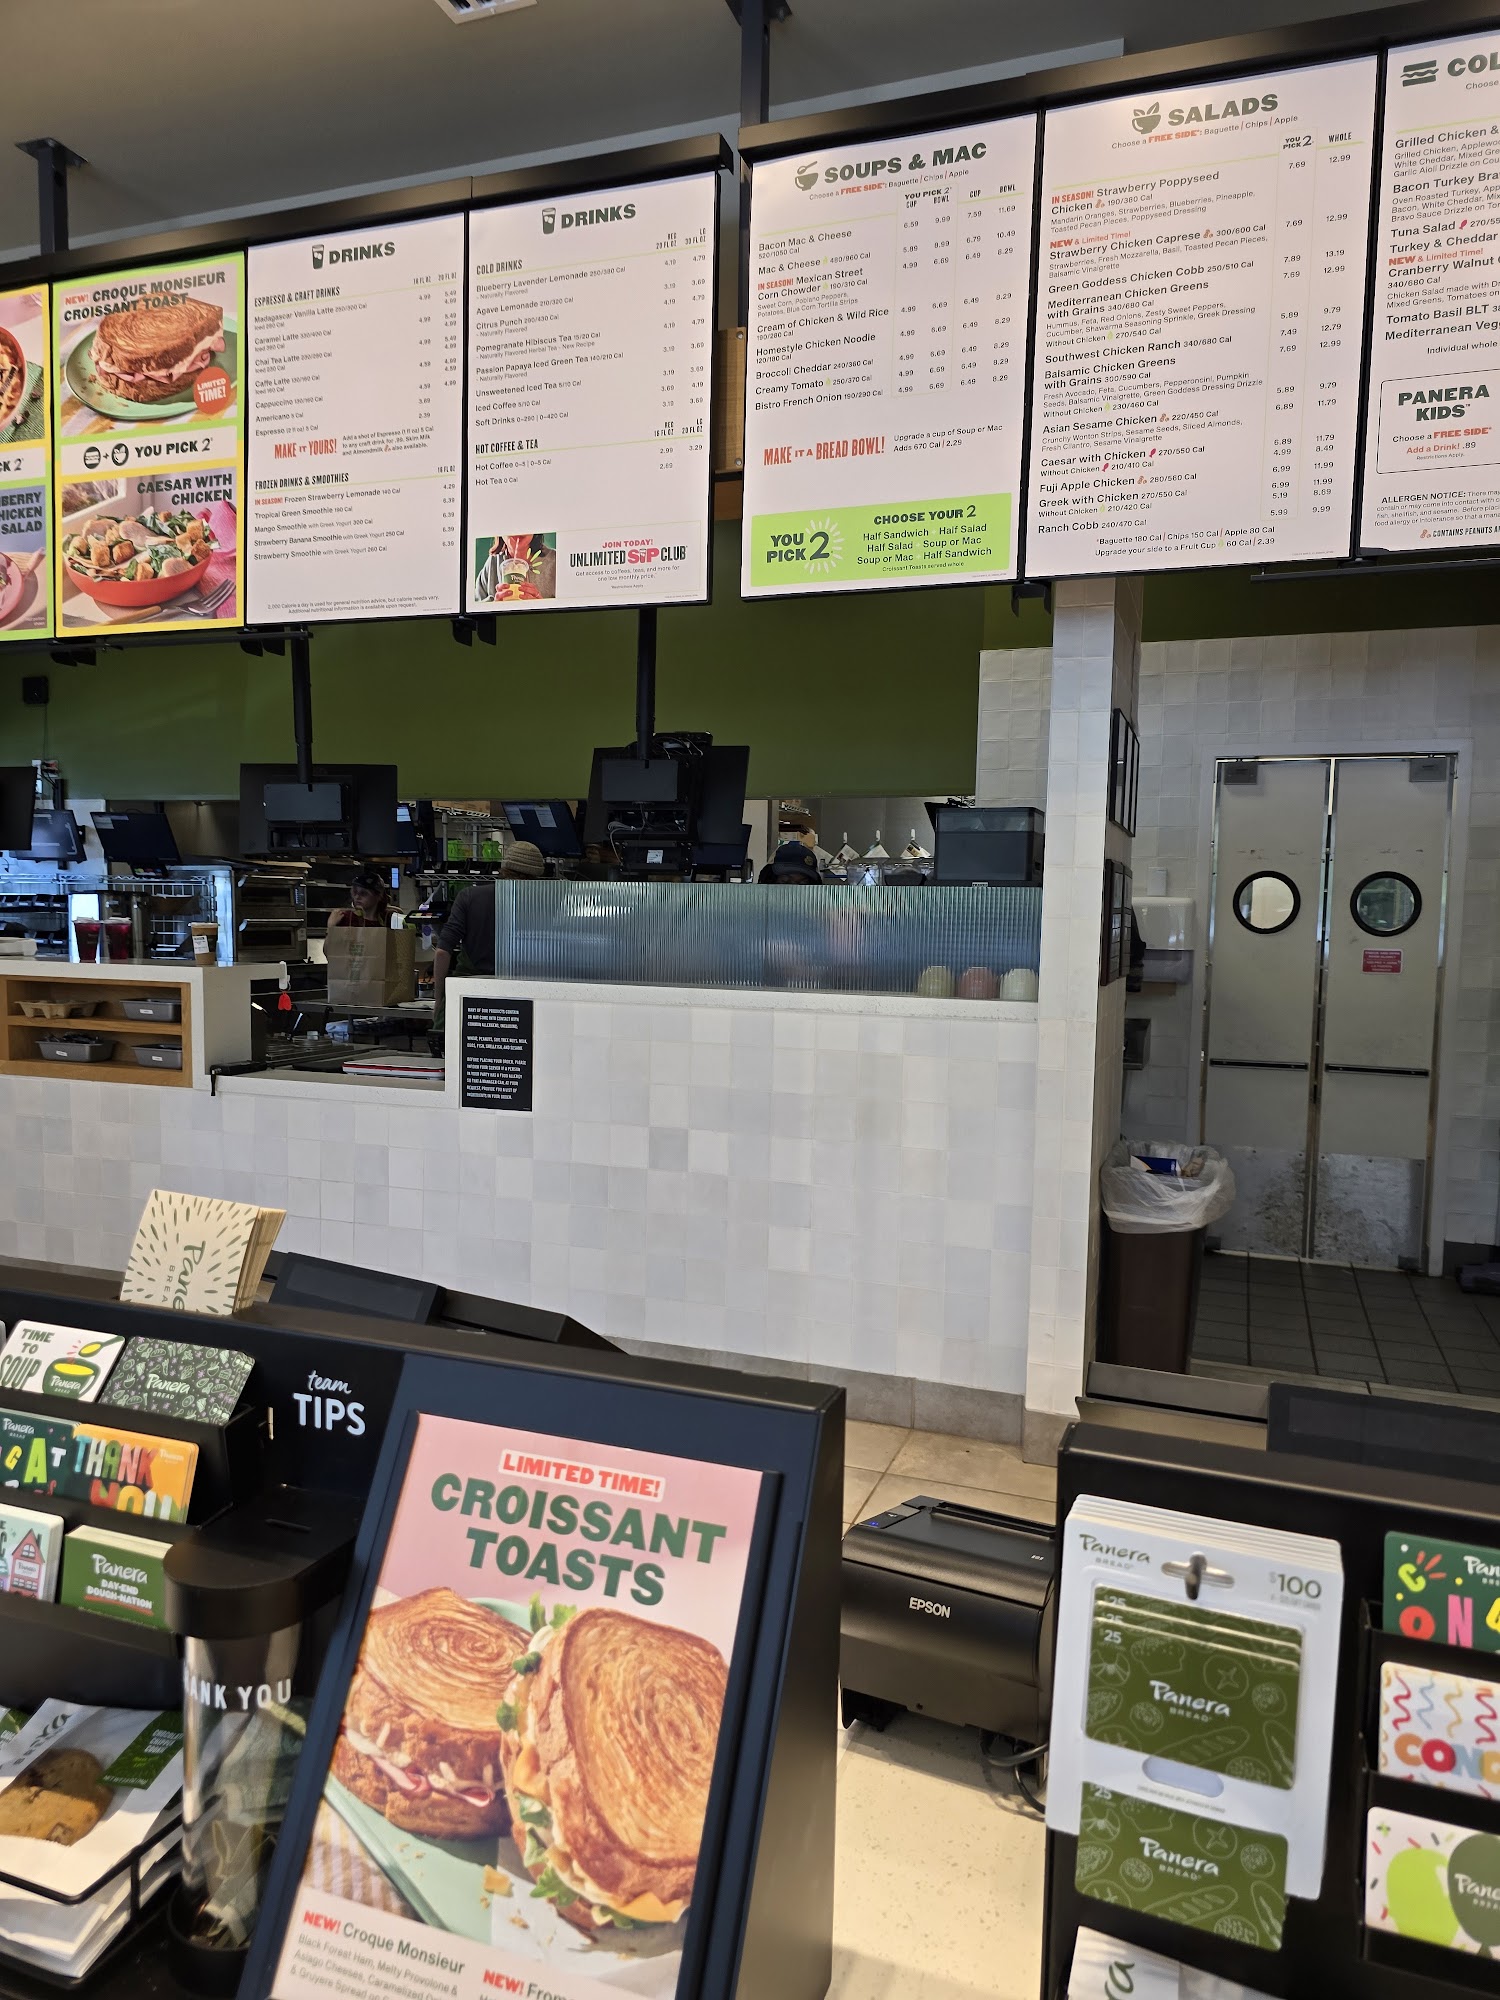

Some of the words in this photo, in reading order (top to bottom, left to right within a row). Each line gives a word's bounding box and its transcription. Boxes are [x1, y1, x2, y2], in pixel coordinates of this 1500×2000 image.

[1168, 93, 1279, 127] SALADS
[1328, 131, 1352, 143] WHOLE
[824, 156, 902, 184] SOUPS
[908, 153, 927, 171] &
[932, 142, 987, 167] MAC
[1289, 160, 1306, 169] 7.69
[1329, 154, 1351, 163] 12.99
[1393, 182, 1430, 194] Bacon
[1433, 175, 1475, 188] Turkey
[561, 203, 636, 230] DRINKS
[1390, 227, 1420, 238] Tuna
[1422, 220, 1456, 234] Salad
[328, 241, 396, 265] DRINKS
[1049, 245, 1108, 260] Strawberry
[1110, 238, 1153, 251] Chicken
[1155, 232, 1201, 245] Caprese
[1389, 241, 1431, 254] Turkey
[1433, 238, 1443, 248] &
[1446, 232, 1499, 246] Cheddar
[476, 263, 494, 275] COLD
[496, 259, 523, 273] DRINKS
[65, 294, 89, 305] NEW!
[92, 283, 147, 302] CROQUE
[150, 271, 226, 295] MONSIEUR
[1048, 283, 1079, 294] Green
[1081, 276, 1128, 289] Goddess
[1130, 270, 1173, 282] Chicken
[1175, 265, 1205, 277] Cobb
[64, 300, 139, 322] CROISSANT
[145, 292, 189, 310] TOAST
[254, 294, 286, 308] ESPRESSO
[287, 293, 293, 303] &
[294, 289, 314, 302] CRAFT
[316, 286, 340, 299] DRINKS
[757, 323, 785, 333] Cream
[787, 319, 797, 329] of
[798, 316, 835, 327] Chicken
[836, 313, 844, 322] &
[846, 310, 866, 321] Wild
[868, 308, 889, 318] Rice
[1386, 312, 1430, 325] Tomato
[1433, 306, 1462, 320] Basil
[1465, 303, 1490, 316] BLT
[756, 343, 803, 357] Homestyle
[805, 338, 841, 350] Chicken
[1045, 349, 1100, 364] Southwest
[1102, 345, 1145, 357] Chicken
[1147, 339, 1181, 352] Ranch
[755, 367, 792, 380] Broccoli
[793, 363, 832, 375] Cheddar
[197, 377, 227, 391] LIMITED
[198, 386, 227, 403] TIME!
[1398, 384, 1490, 407] PANERA
[1042, 424, 1071, 435] Asian
[1072, 420, 1113, 431] Sesame
[1115, 415, 1157, 427] Chicken
[135, 444, 162, 458] YOU
[166, 440, 198, 455] PICK
[274, 443, 297, 459] MAKE
[308, 438, 337, 456] YOURS!
[475, 443, 489, 454] HOT
[490, 441, 516, 453] COFFEE
[517, 440, 524, 451] &
[525, 438, 539, 450] TEA
[763, 446, 792, 466] MAKE
[794, 449, 805, 458] IT
[805, 448, 814, 457] A
[816, 439, 849, 461] BREAD
[851, 436, 884, 457] BOWL!
[1406, 446, 1424, 454] Add
[1433, 443, 1460, 452] Drink!
[137, 477, 192, 494] CAESAR
[195, 473, 233, 488] WITH
[255, 479, 278, 490] FROZEN
[279, 477, 303, 488] DRINKS
[304, 476, 310, 486] &
[311, 472, 349, 485] SMOOTHIES
[171, 488, 233, 506] CHICKEN
[1381, 494, 1429, 504] ALLERGEN
[1430, 490, 1466, 500] NOTICE:
[873, 512, 925, 525] CHOOSE
[928, 509, 964, 521] YOUR
[966, 504, 976, 518] 2
[1, 521, 42, 535] SALAD
[863, 531, 882, 541] Half
[883, 528, 929, 540] Sandwich
[939, 525, 958, 535] Half
[960, 523, 987, 533] Salad
[1038, 523, 1069, 534] Ranch
[1071, 521, 1099, 531] Cobb
[602, 541, 622, 549] JOIN
[623, 539, 653, 547] TODAY!
[770, 532, 804, 548] YOU
[570, 550, 626, 568] UNLIMITED
[766, 547, 807, 564] PICK
[21, 1328, 55, 1343] TIME
[21, 1342, 39, 1354] TO
[147, 1374, 191, 1394] Panera
[308, 1370, 352, 1395] team
[293, 1393, 366, 1436] TIPS
[2, 1417, 35, 1435] Panera
[73, 1435, 159, 1489] THANK
[502, 1452, 595, 1485] LIMITED
[597, 1470, 661, 1498] TIME!
[431, 1472, 727, 1564] CROISSANT
[1079, 1533, 1150, 1563] Panera
[91, 1554, 148, 1584] Panera
[465, 1528, 667, 1607] TOASTS
[101, 1579, 139, 1595] DAY-END
[909, 1597, 951, 1619] EPSON
[237, 1678, 292, 1710] YOU
[1150, 1679, 1231, 1717] Panera
[1139, 1836, 1219, 1876] Panera
[303, 1910, 341, 1934] NEW!
[343, 1922, 394, 1951] Croque
[397, 1940, 466, 1974] Monsieur
[298, 1933, 321, 1948] Black
[323, 1941, 351, 1958] Forest
[353, 1950, 375, 1969] Ham,
[404, 1968, 450, 1994] Provolone
[482, 1968, 525, 1996] NEW!
